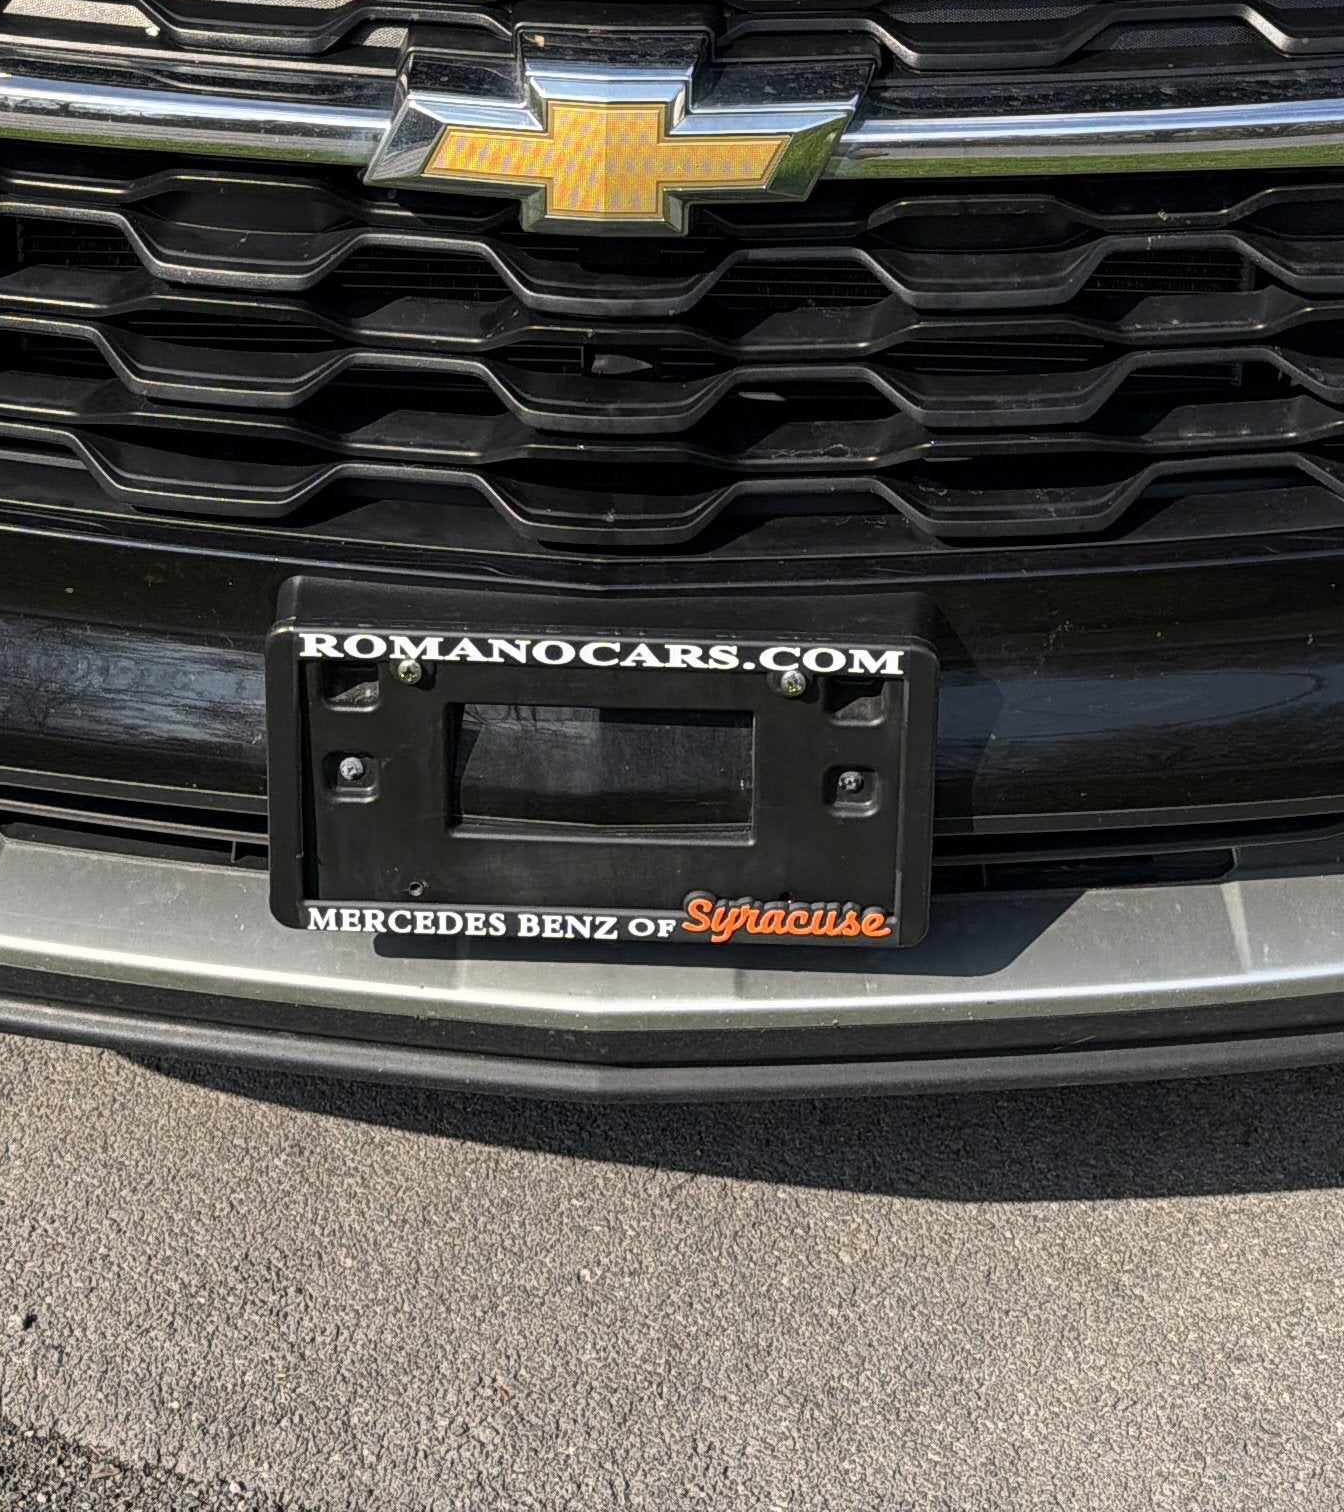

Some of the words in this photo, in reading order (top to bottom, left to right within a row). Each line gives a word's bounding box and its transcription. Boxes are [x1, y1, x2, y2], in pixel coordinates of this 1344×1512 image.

[298, 632, 905, 676] ROMANOCARS.COM
[307, 907, 507, 936] MERCEDES
[517, 913, 619, 940] BENZ
[627, 917, 677, 938] OF
[682, 899, 893, 944] Syracuse
